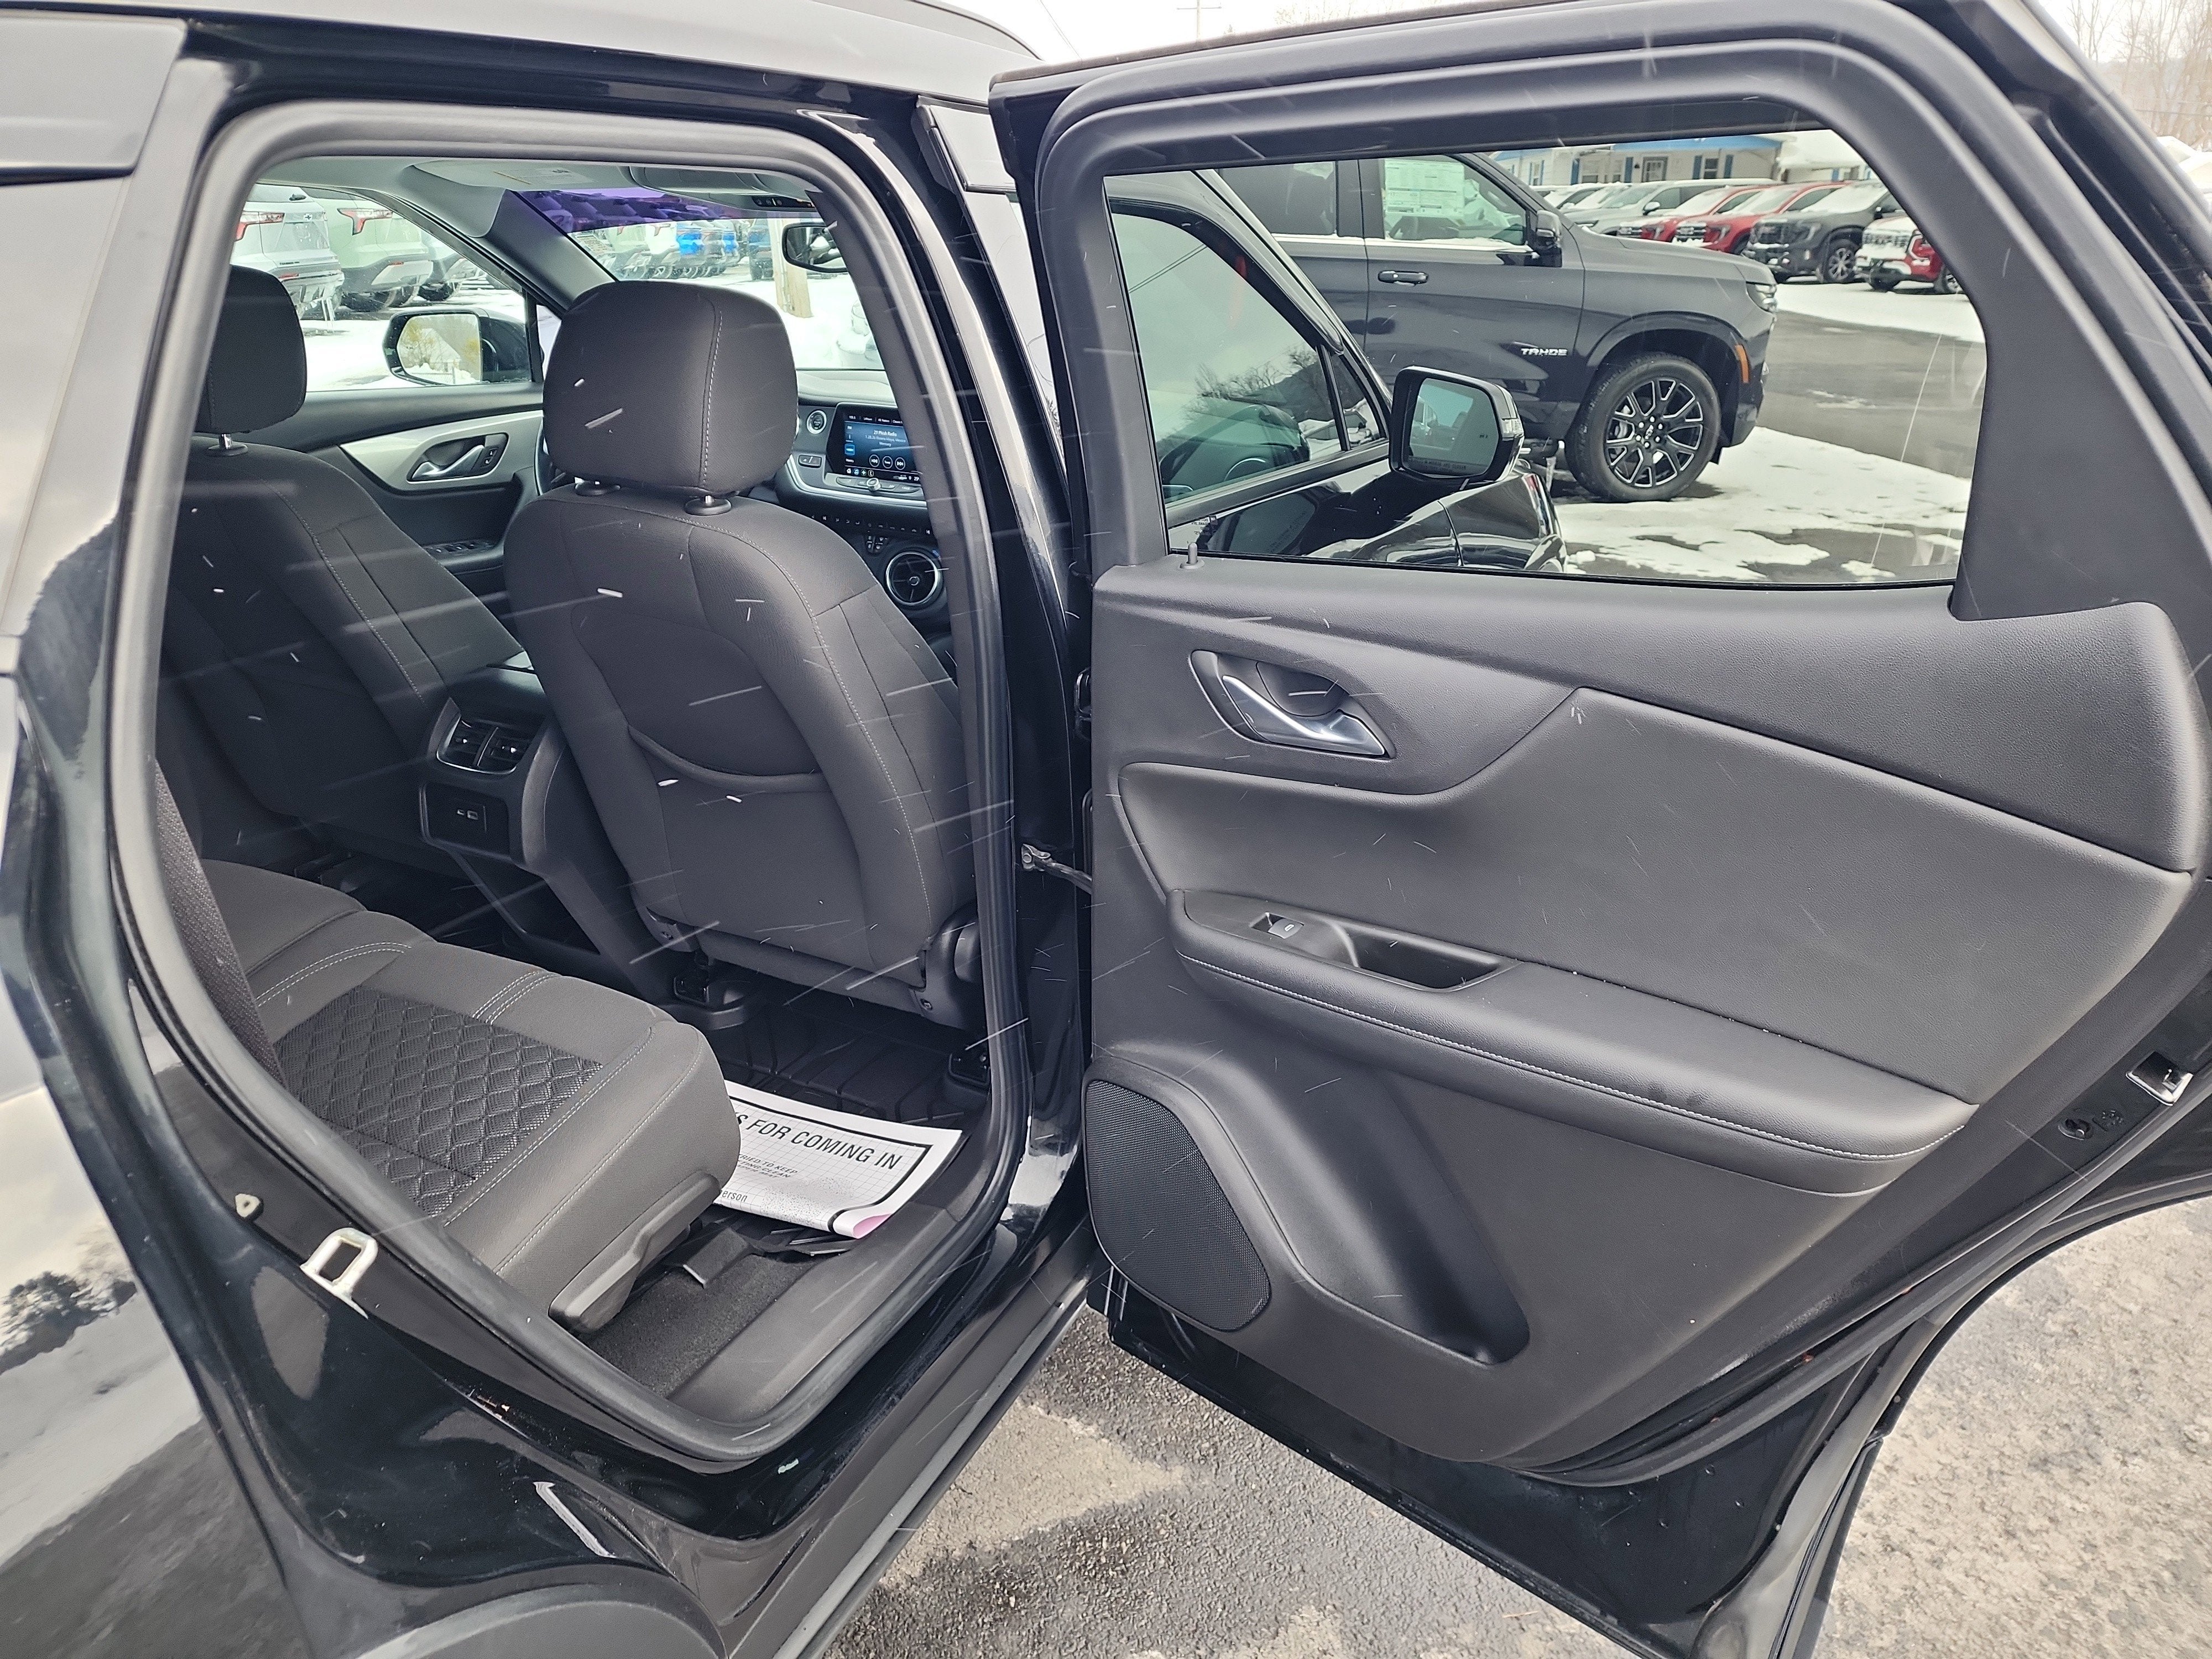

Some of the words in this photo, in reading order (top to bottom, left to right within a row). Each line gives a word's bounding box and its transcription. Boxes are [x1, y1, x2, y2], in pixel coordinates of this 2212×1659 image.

[1521, 348, 1568, 356] TAHOE
[745, 1119, 791, 1140] FOR
[791, 1131, 875, 1162] COMING
[874, 1152, 903, 1170] IN
[761, 1167, 791, 1178] CLEAN
[774, 1165, 798, 1173] KEEP
